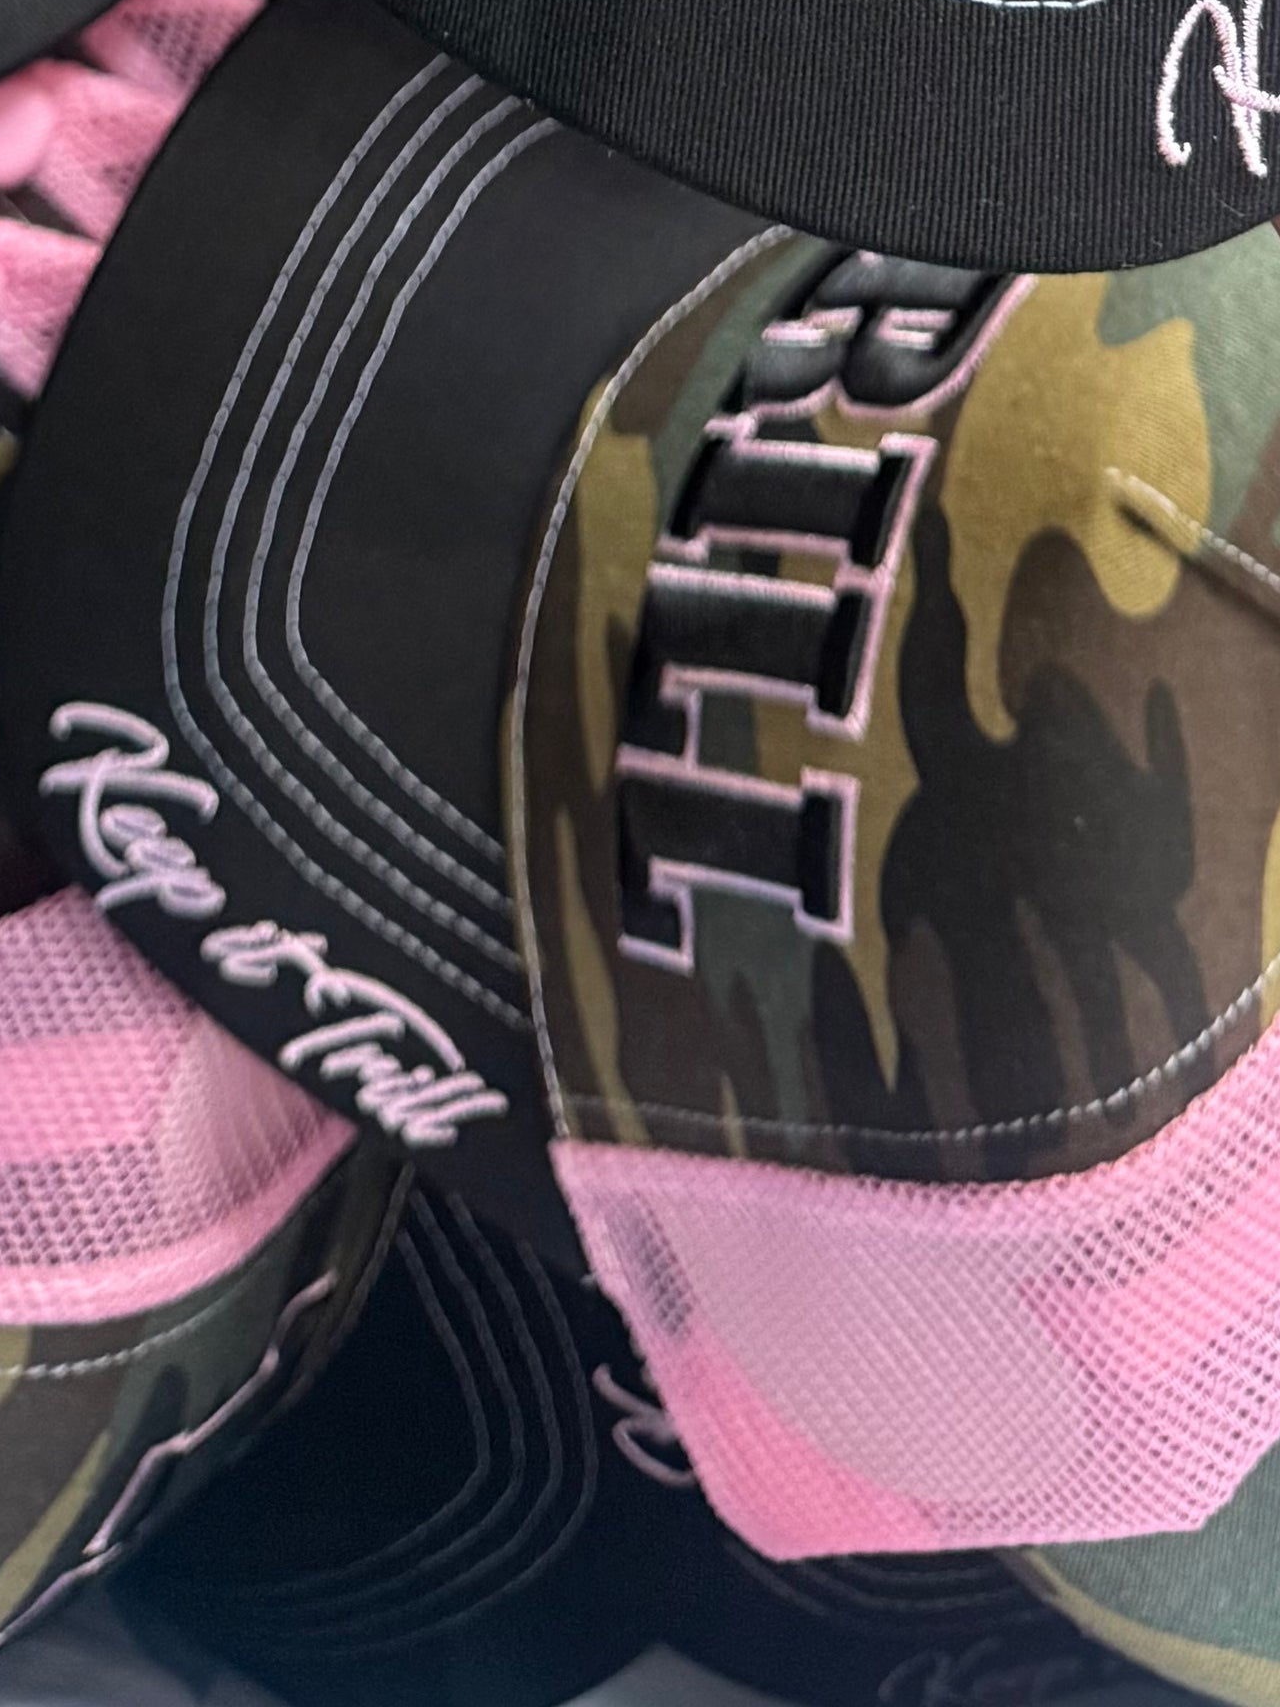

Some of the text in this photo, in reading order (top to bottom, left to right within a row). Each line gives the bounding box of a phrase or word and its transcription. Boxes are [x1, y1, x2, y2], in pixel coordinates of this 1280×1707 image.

[38, 699, 510, 1149] Keep it Trill
